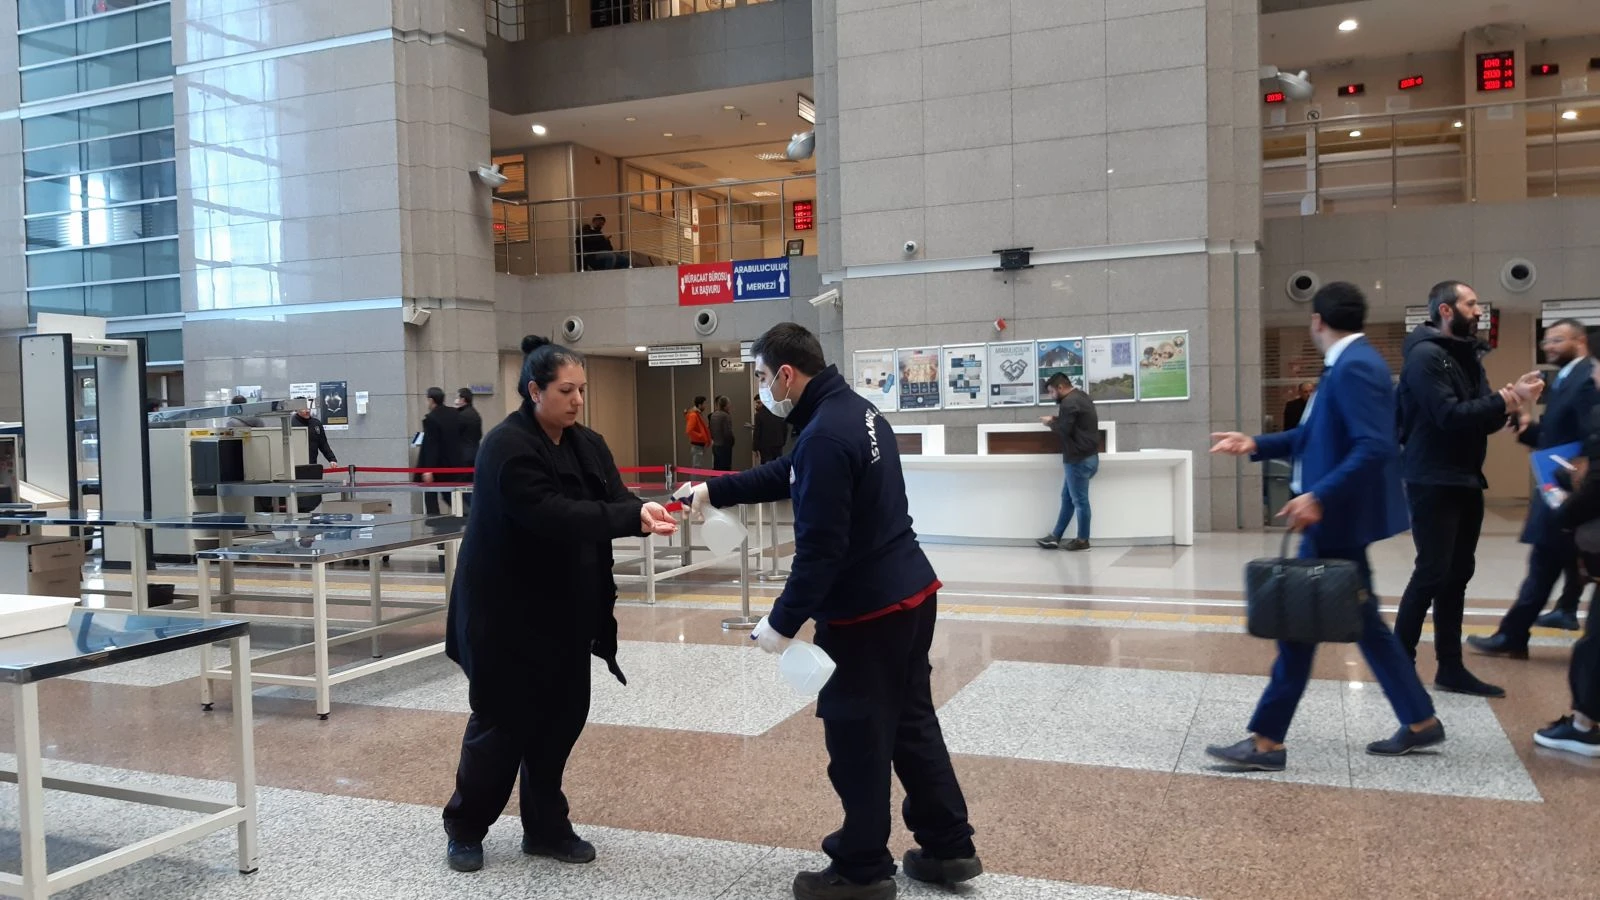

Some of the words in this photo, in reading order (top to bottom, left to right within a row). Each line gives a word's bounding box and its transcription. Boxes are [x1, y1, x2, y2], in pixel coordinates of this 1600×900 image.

[734, 263, 788, 274] ARABULUCULUK
[684, 272, 708, 284] MÜRACAAT
[709, 270, 728, 282] BÜROSU
[700, 285, 720, 296] BAŞVURU
[746, 281, 777, 291] MERKEZİ
